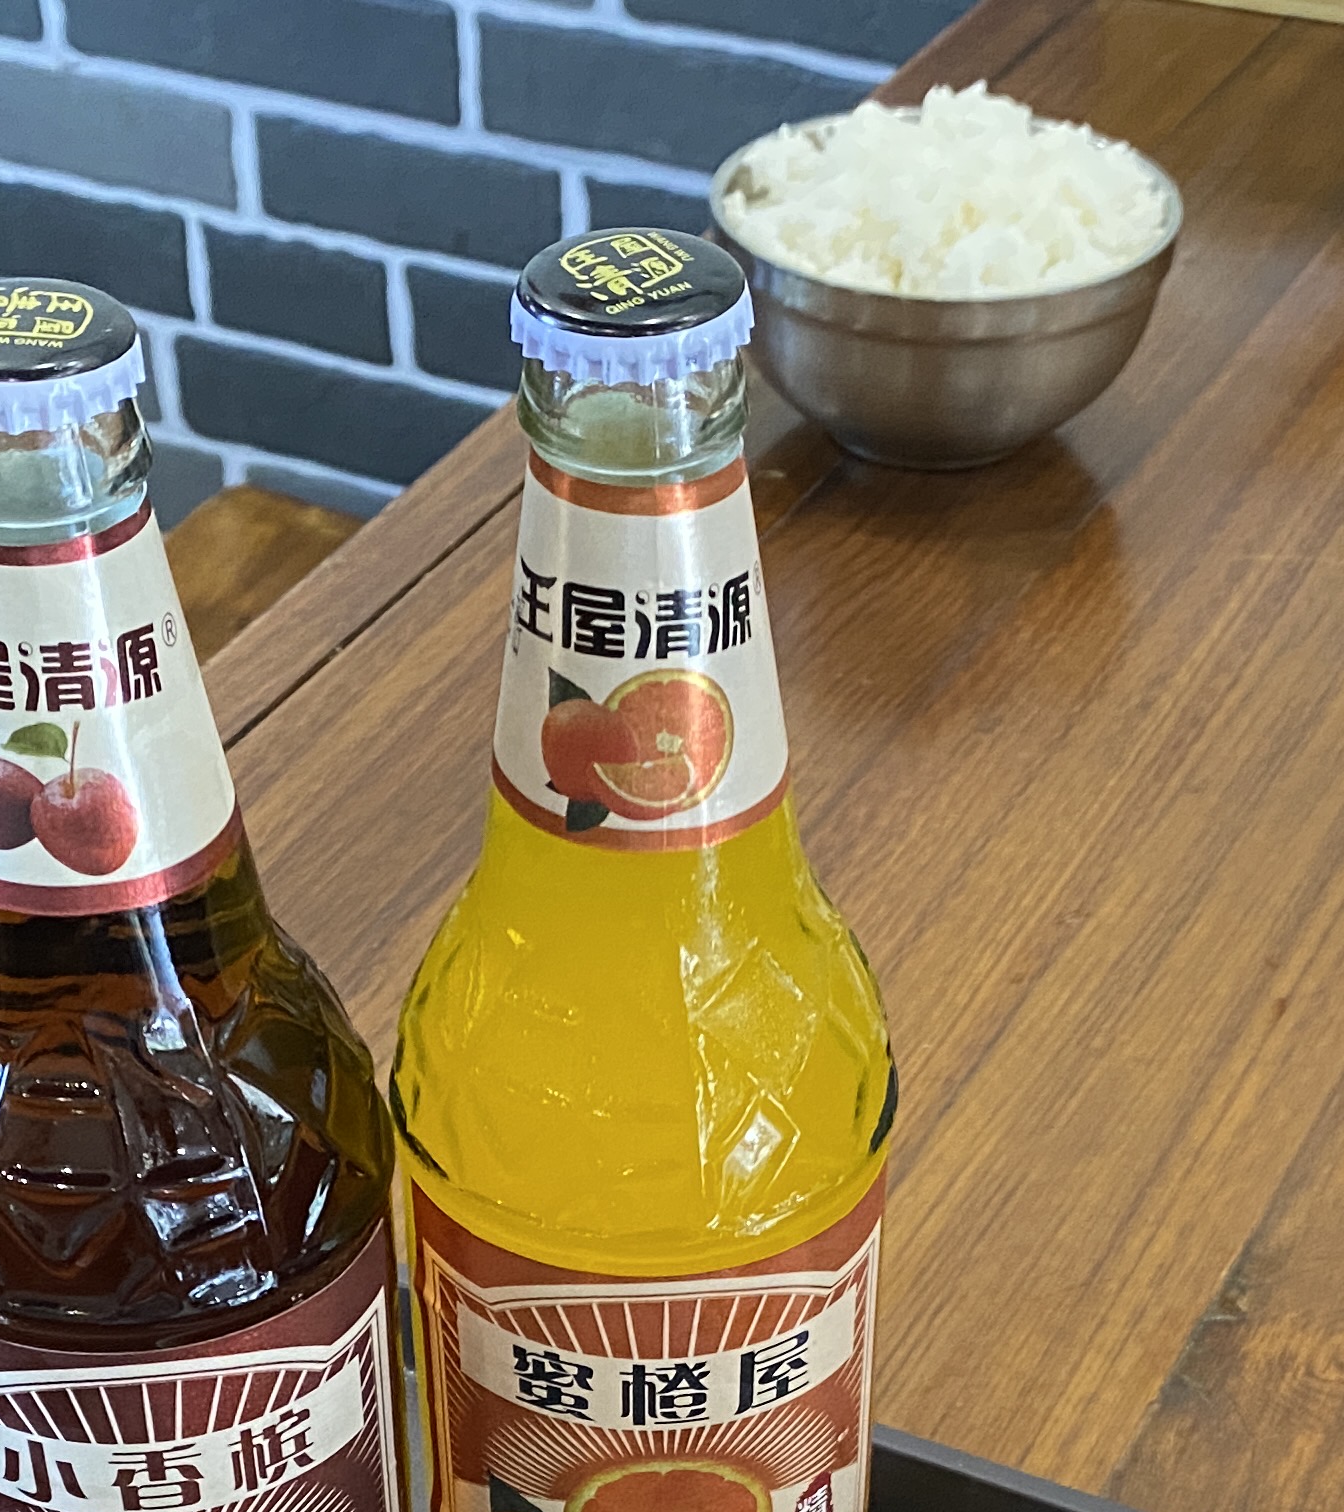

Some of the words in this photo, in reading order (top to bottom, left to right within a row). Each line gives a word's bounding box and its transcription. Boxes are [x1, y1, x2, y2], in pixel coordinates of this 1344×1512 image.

[14, 338, 64, 349] WANG
[605, 296, 645, 315] QING
[647, 281, 693, 301] YUAN
[518, 555, 752, 660] 王屋清源
[512, 1329, 810, 1426] 蜜橙屋
[2, 1407, 316, 1512] 小香槟
